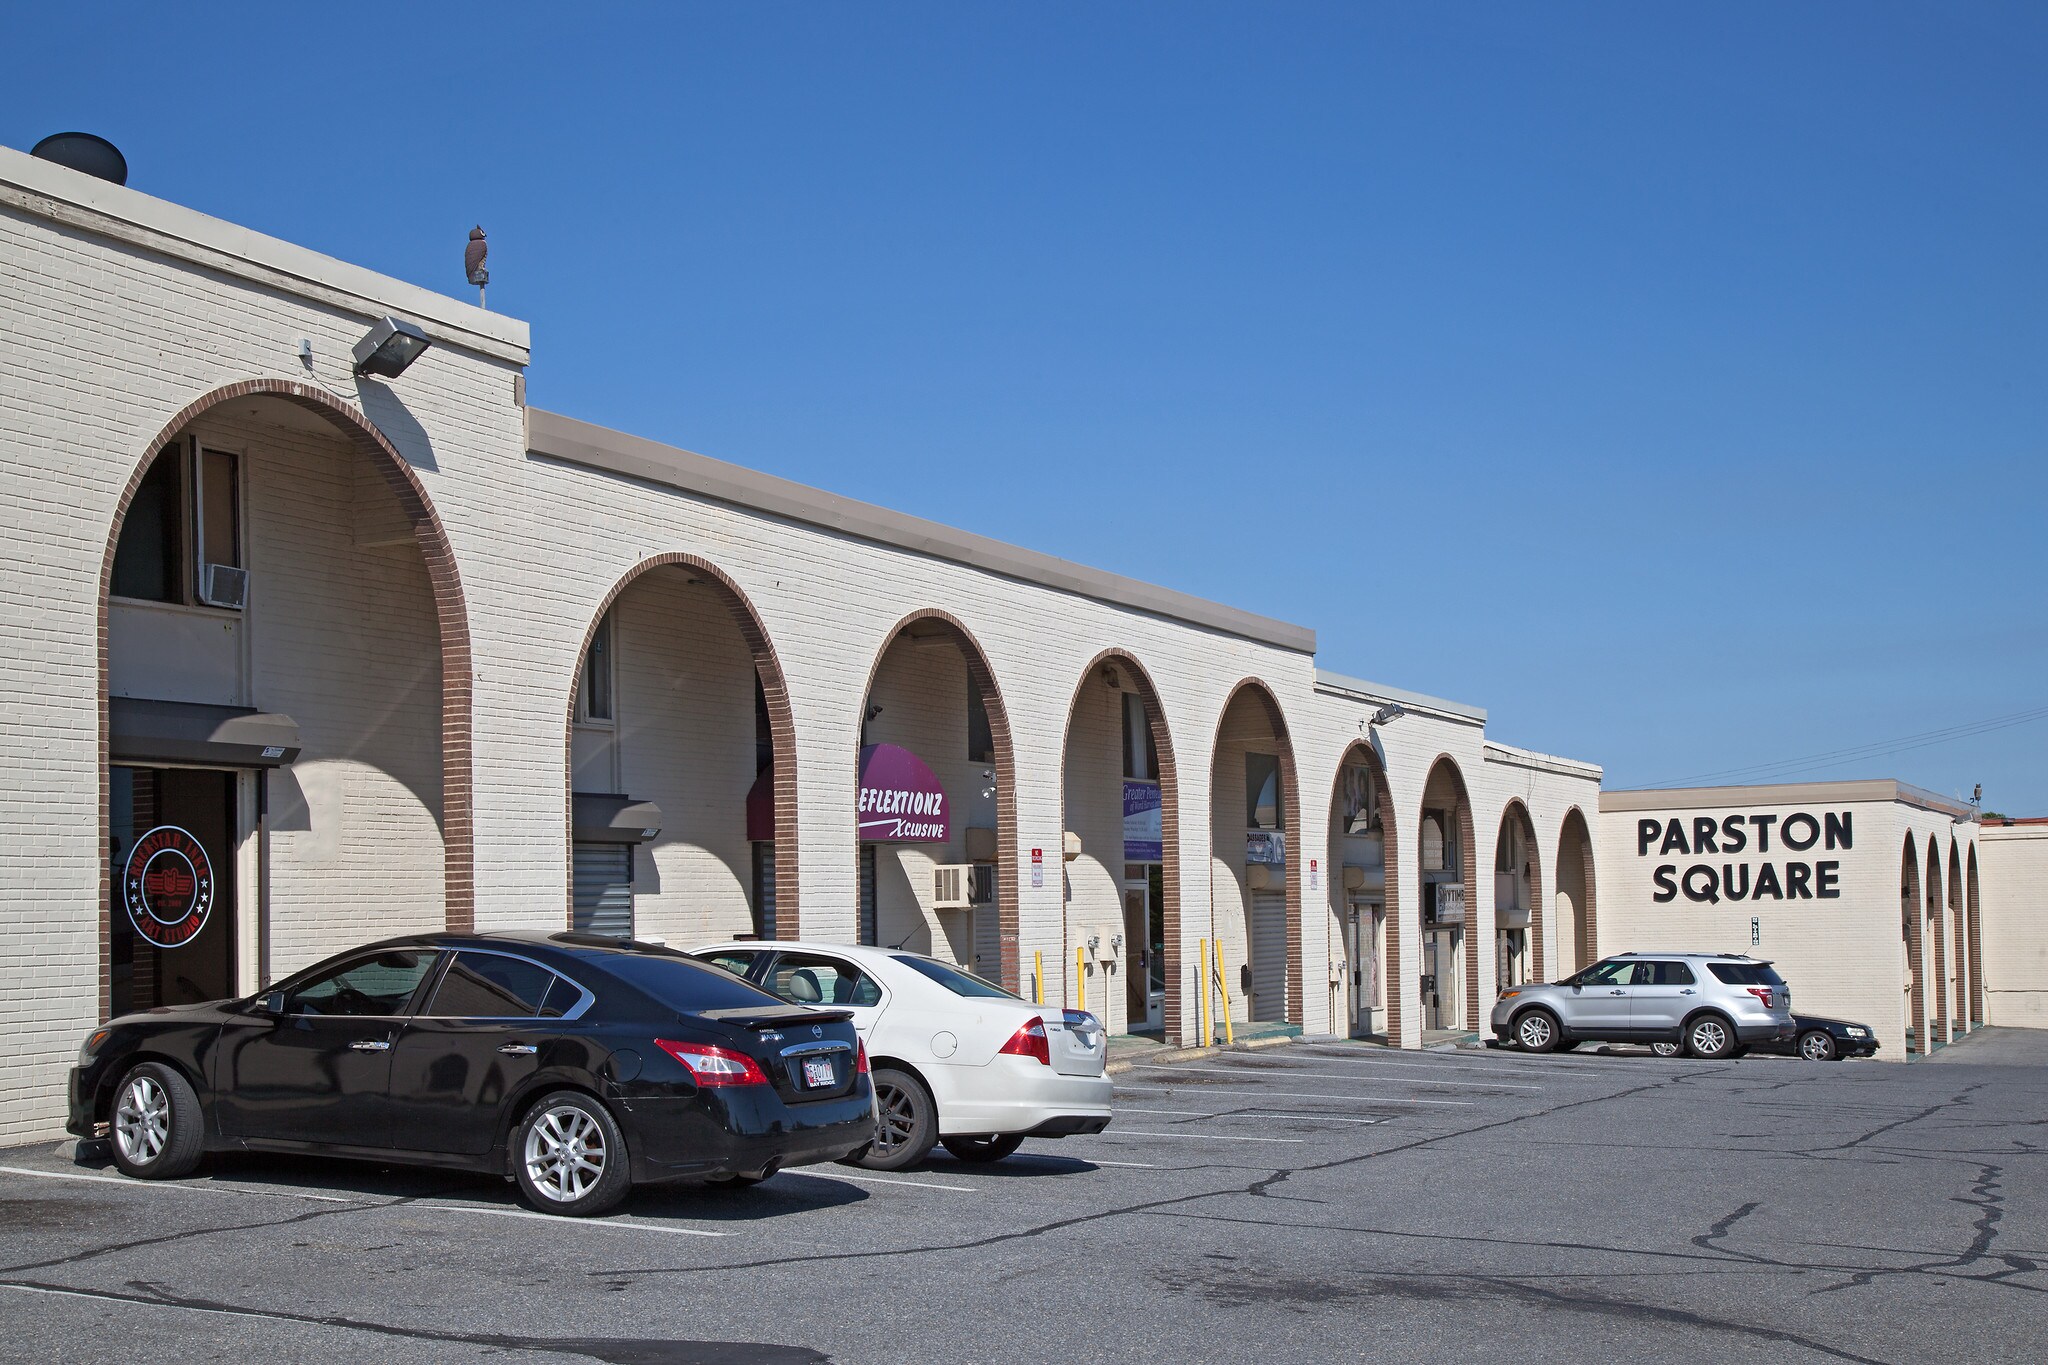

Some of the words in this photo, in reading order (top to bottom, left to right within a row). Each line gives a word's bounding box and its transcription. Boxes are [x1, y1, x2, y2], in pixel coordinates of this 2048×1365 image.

[888, 819, 945, 838] XCLUSIVE
[1637, 811, 1853, 857] PARSTON
[129, 832, 181, 878] ROCKSTAR
[1653, 861, 1841, 905] SQUARE
[140, 915, 162, 940] ART
[164, 915, 200, 943] STUDIO
